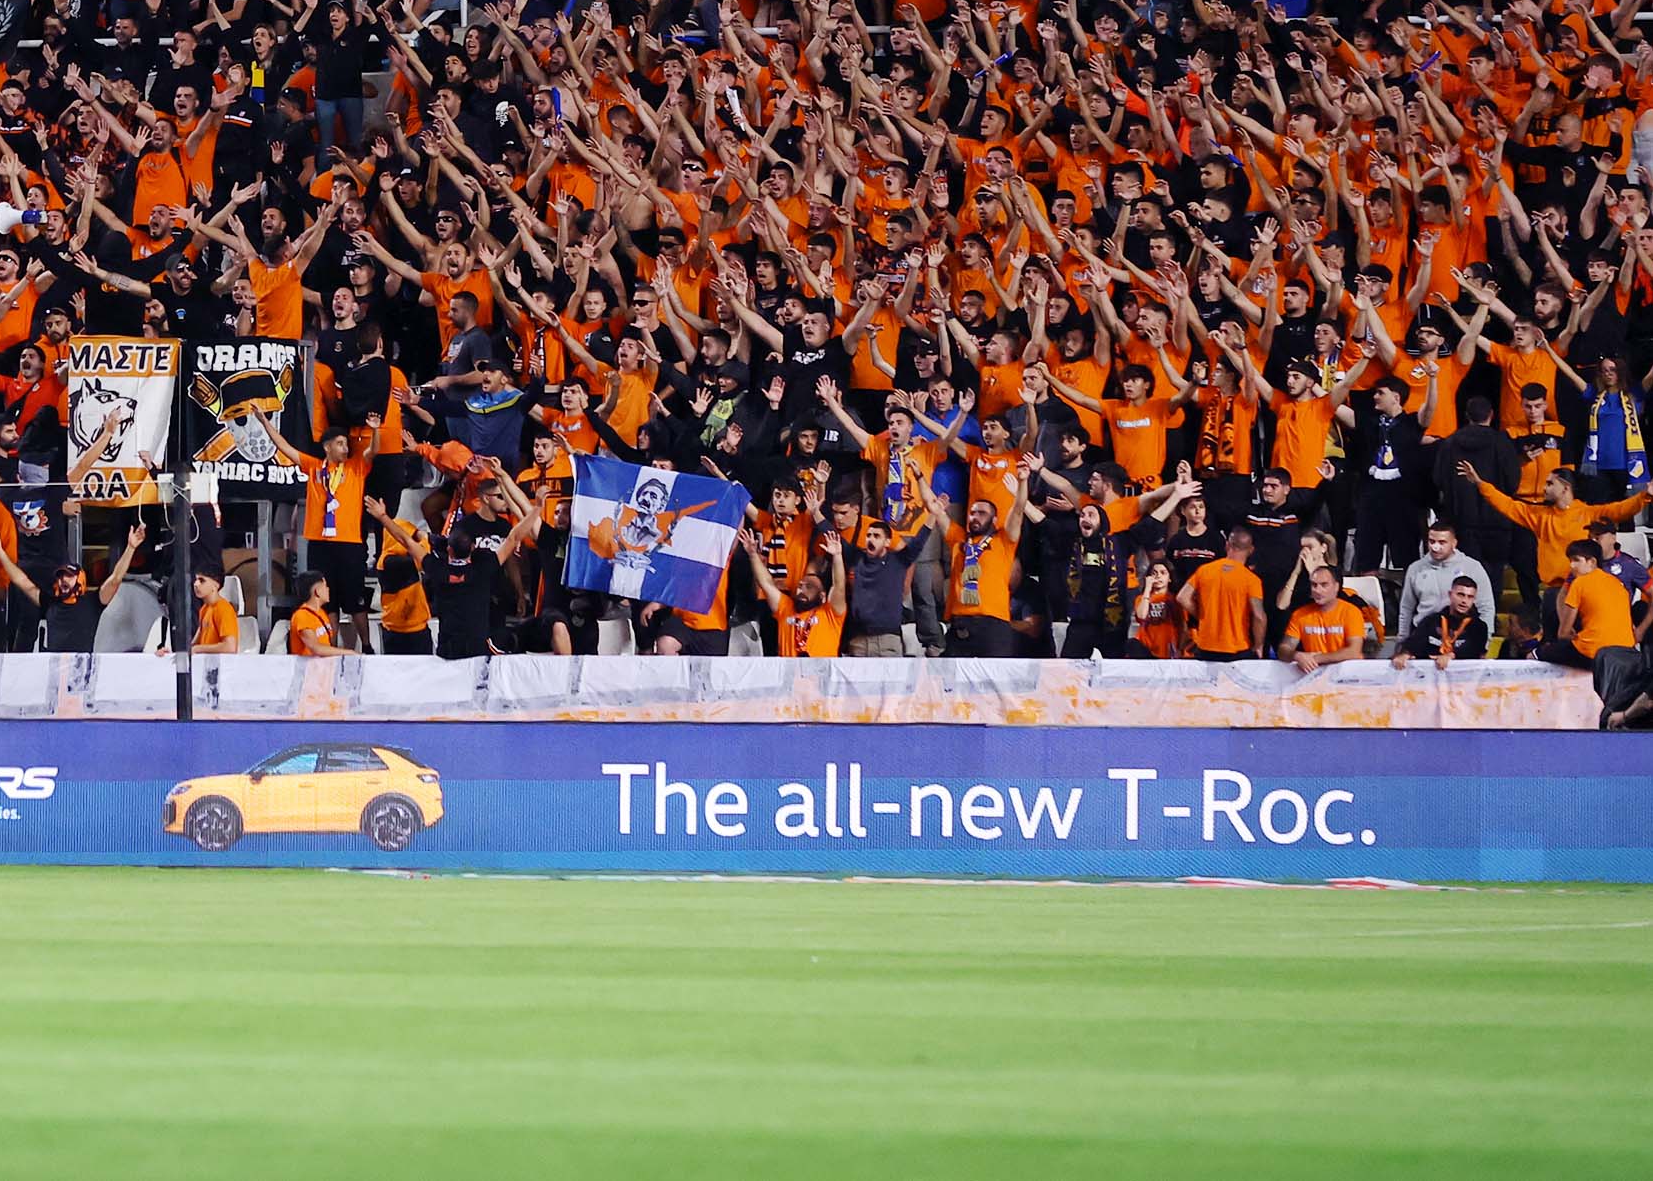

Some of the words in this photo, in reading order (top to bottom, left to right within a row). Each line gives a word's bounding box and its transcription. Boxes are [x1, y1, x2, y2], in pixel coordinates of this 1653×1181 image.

[602, 763, 748, 837] The
[775, 763, 1084, 842] all-new
[1108, 767, 1377, 847] T-Roc.
